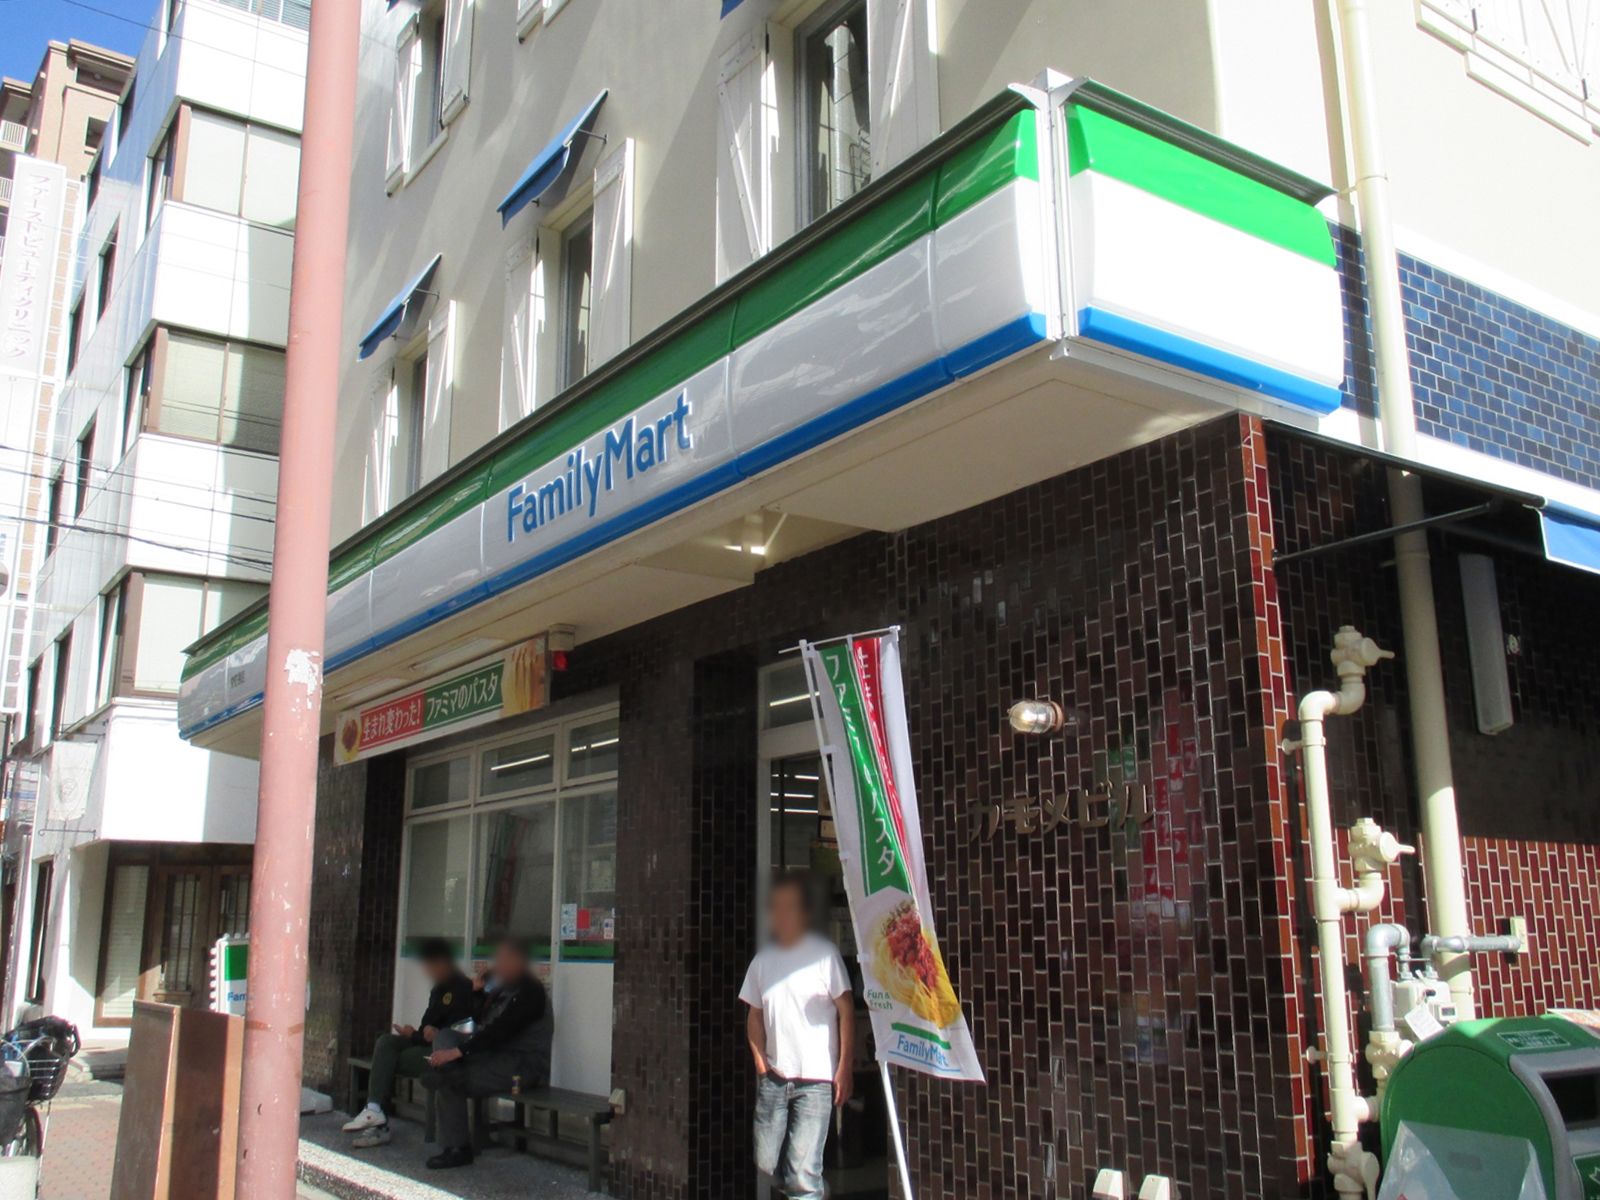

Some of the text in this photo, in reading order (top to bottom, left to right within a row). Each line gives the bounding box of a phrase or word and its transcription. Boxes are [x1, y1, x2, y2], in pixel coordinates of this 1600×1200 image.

[508, 388, 694, 543] FamilyMart
[426, 672, 498, 721] ファミマのパスタ
[968, 779, 1155, 841] カモメビル
[897, 1034, 949, 1066] FamilyMt
